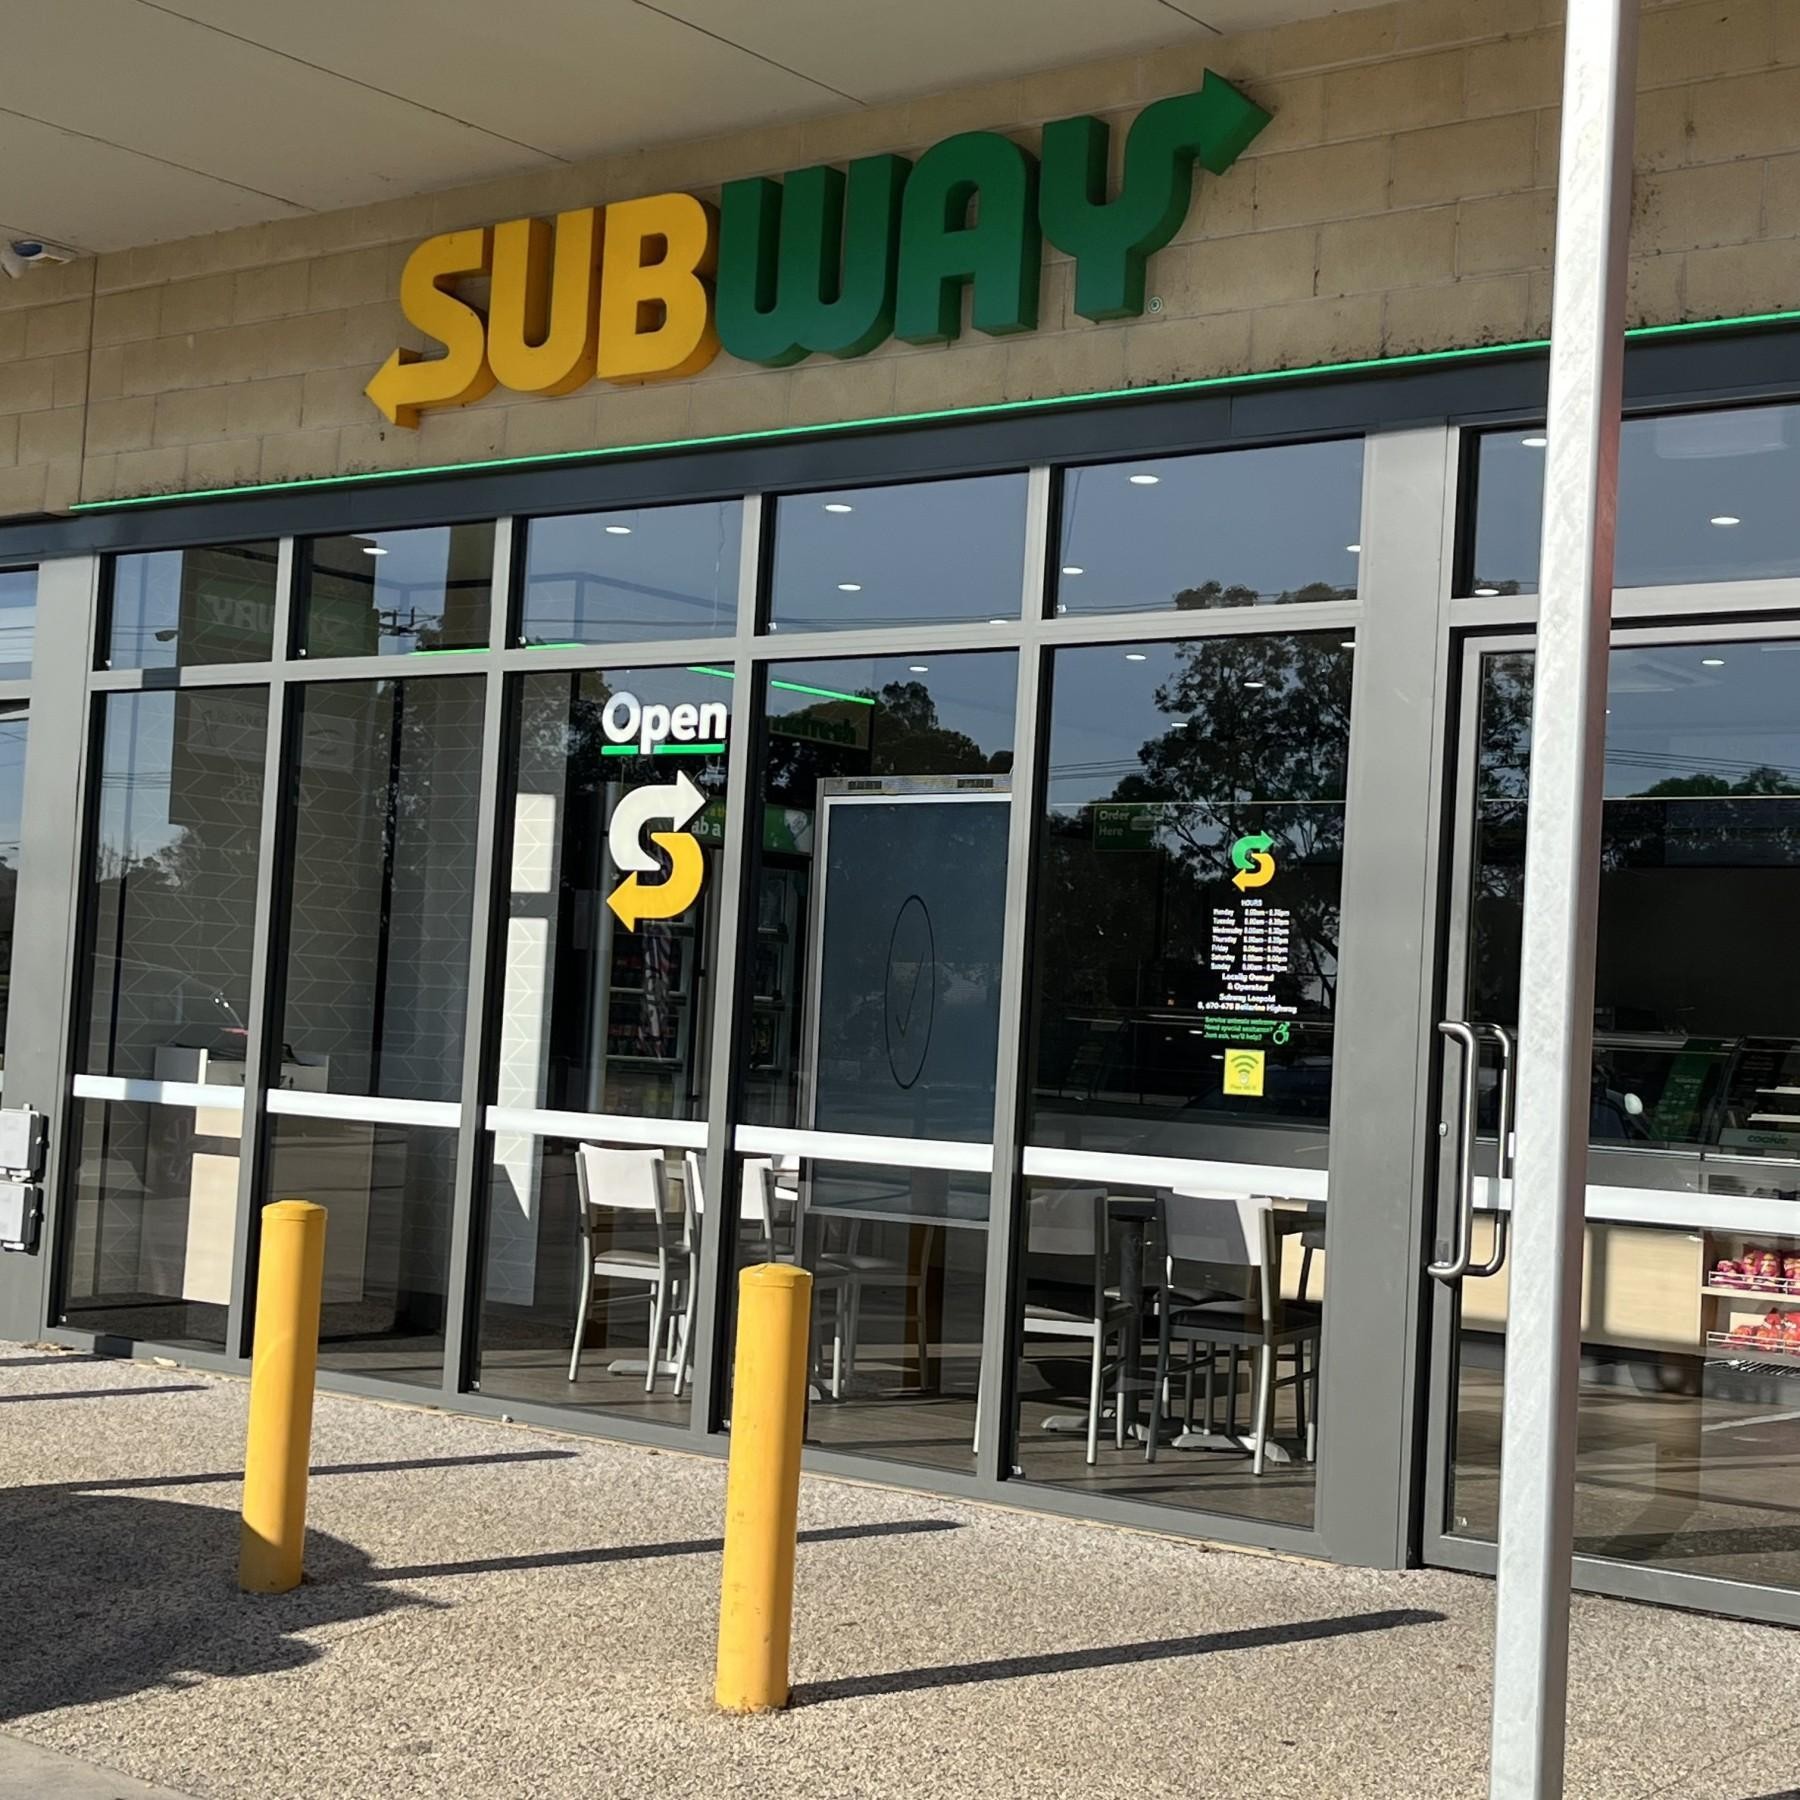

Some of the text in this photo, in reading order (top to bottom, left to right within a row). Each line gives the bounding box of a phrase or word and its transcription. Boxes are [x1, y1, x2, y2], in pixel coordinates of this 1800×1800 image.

[365, 68, 1273, 428] SUBWAY
[602, 691, 727, 755] Open
[1099, 809, 1130, 822] Order
[691, 816, 709, 835] ab
[1098, 825, 1124, 837] Here
[1222, 972, 1275, 983] Locally Owned
[1234, 983, 1268, 992] Operated
[1219, 993, 1246, 1003] Subway
[1267, 1003, 1298, 1015] Highway
